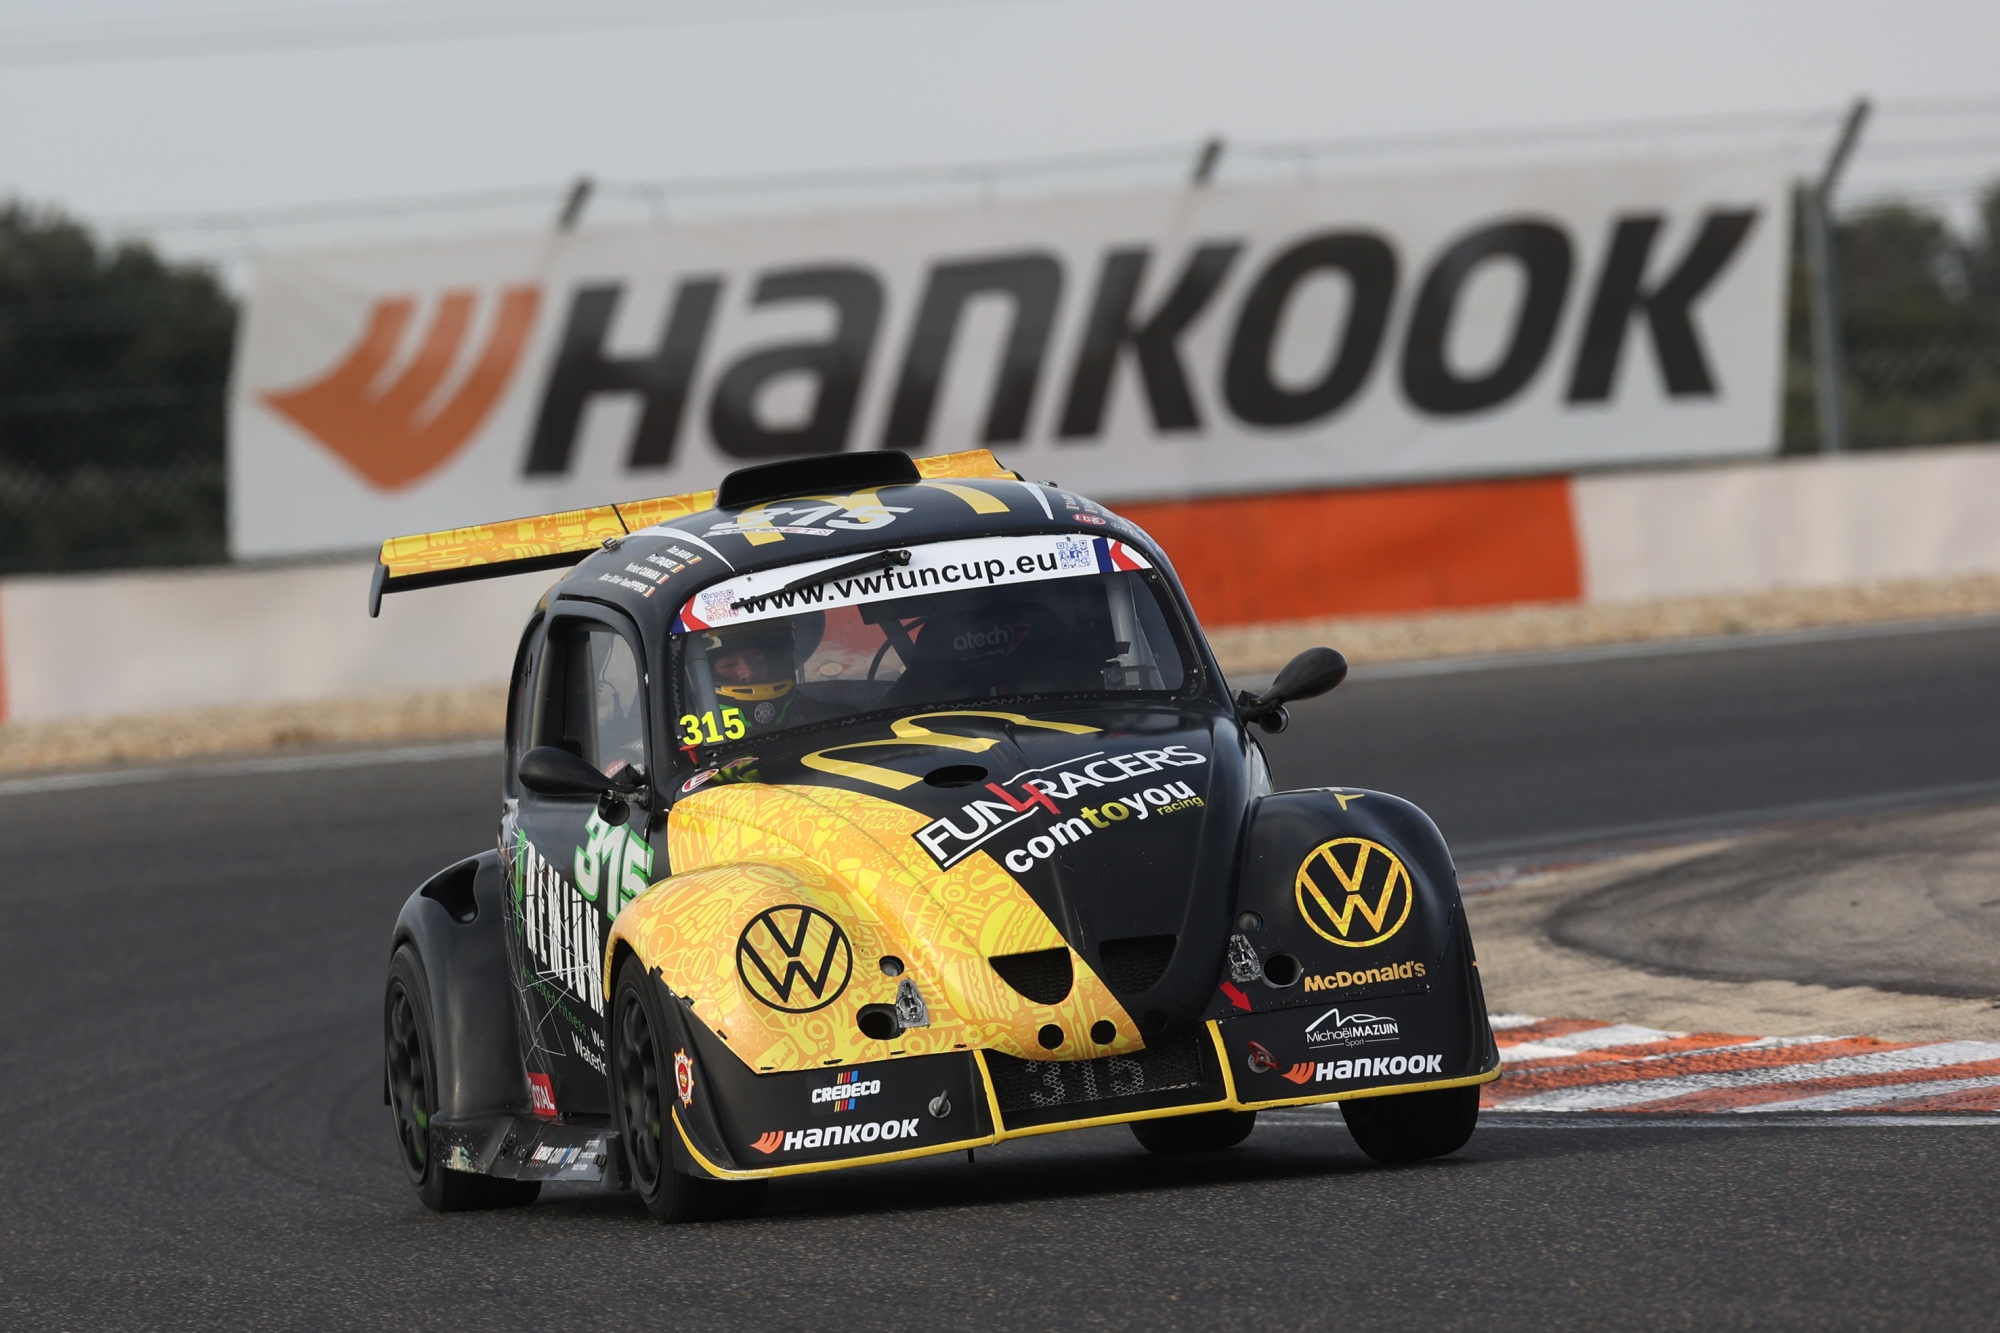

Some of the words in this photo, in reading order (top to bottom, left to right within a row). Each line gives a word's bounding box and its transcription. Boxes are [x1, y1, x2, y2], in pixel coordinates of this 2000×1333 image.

[710, 506, 913, 530] 315
[739, 552, 1058, 614] www.vwfuncup.eu
[679, 707, 746, 746] 315
[1156, 796, 1206, 816] racing
[574, 806, 655, 922] 315
[1303, 960, 1427, 992] McDonald's
[1344, 1038, 1365, 1048] Sport
[811, 1079, 881, 1104] CREDECO
